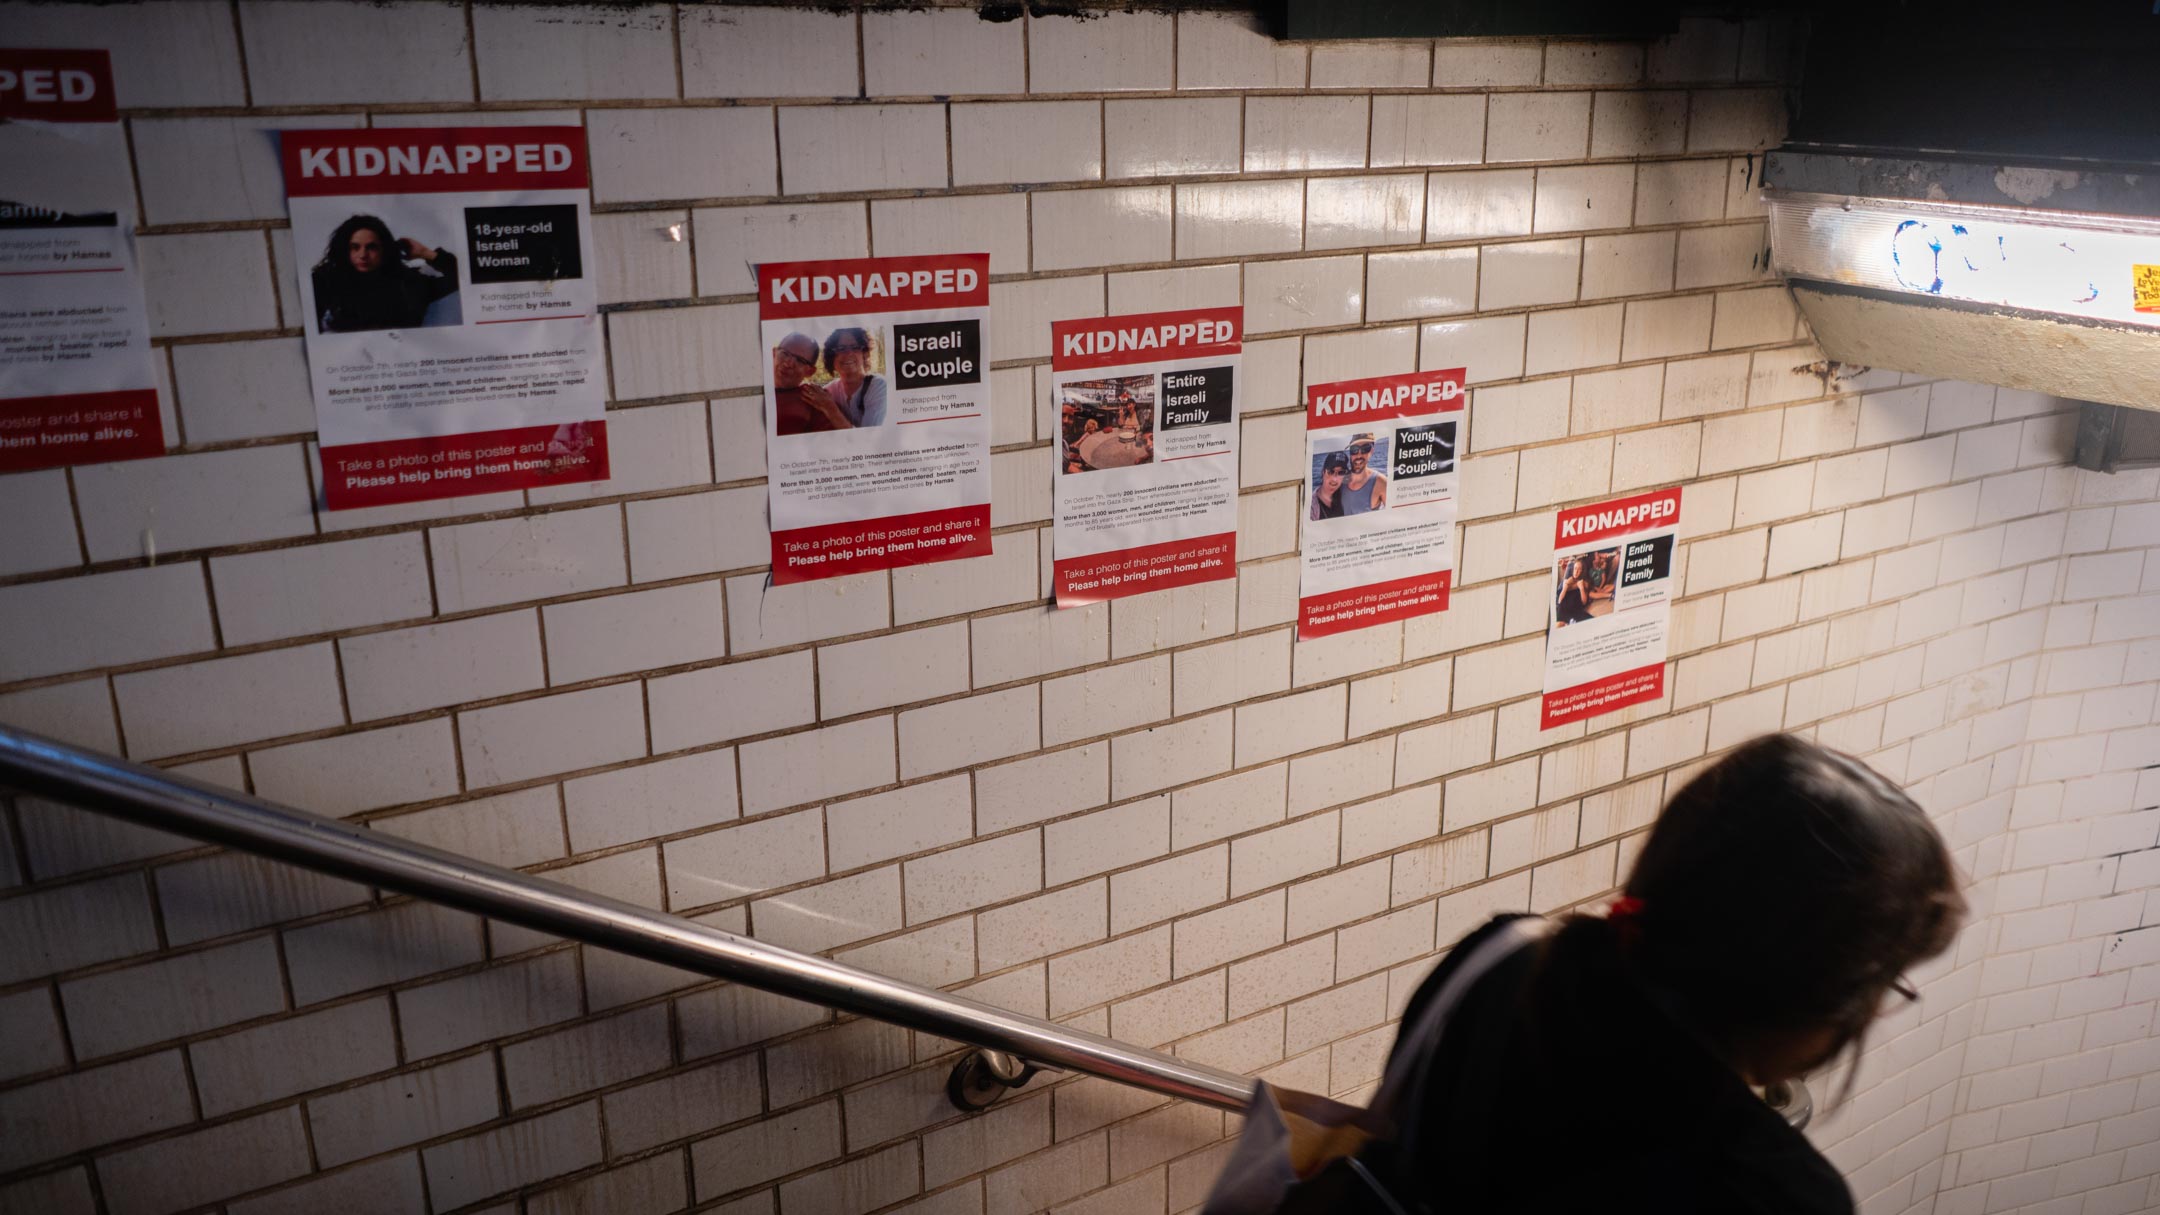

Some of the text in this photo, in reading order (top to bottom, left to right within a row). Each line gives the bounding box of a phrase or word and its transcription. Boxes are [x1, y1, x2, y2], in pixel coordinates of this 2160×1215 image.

[299, 143, 572, 177] KIDNAPPED
[474, 221, 552, 237] 18-year-old
[475, 238, 518, 251] Israeli
[476, 255, 530, 267] Woman
[771, 268, 978, 303] KIDNAPPED
[479, 288, 552, 301] Kidnapped from
[900, 330, 961, 352] Israeli
[1063, 320, 1234, 356] KIDNAPPED
[901, 356, 972, 379] Couple
[1166, 374, 1205, 388] Entire
[901, 394, 940, 404] Kidnapped
[939, 403, 949, 411] by
[950, 401, 974, 409] Hamas
[1166, 390, 1206, 406] Israeli
[1315, 380, 1458, 416] KIDNAPPED
[1166, 408, 1209, 424] Family
[1165, 433, 1211, 443] Kidnapped from
[1400, 428, 1436, 443] Young
[864, 451, 893, 459] innocent
[894, 449, 920, 457] civilians
[936, 443, 965, 452] abducted
[1165, 444, 1178, 453] their
[1206, 439, 1226, 447] Hamas
[1398, 444, 1432, 459] Israeli
[337, 459, 372, 472] Take
[375, 459, 385, 469] a
[388, 453, 428, 469] photo
[431, 450, 444, 463] of
[447, 449, 472, 461] this
[474, 445, 516, 460] poster
[519, 440, 544, 454] and
[346, 475, 395, 488] Please
[398, 470, 431, 483] help
[434, 467, 472, 479] bring
[474, 462, 510, 475] them
[512, 459, 551, 470] home
[1397, 459, 1438, 475] Couple
[1561, 498, 1675, 538] KIDNAPPED
[783, 517, 980, 552] Take a photo of this poster and share it
[788, 533, 976, 566] Please help bring them home alive.
[1628, 543, 1654, 556] Entire
[1063, 543, 1227, 579] Take a photo of this poster and share it
[1626, 554, 1653, 569] Israeli
[1068, 558, 1223, 592] Please help bring them home alive.
[1624, 567, 1654, 582] Family
[1306, 580, 1444, 614] Take a photo of this poster and share it
[1308, 593, 1439, 626] Please help bring them home alive.
[1548, 699, 1563, 708] Take
[1568, 692, 1587, 704] photo
[1586, 689, 1594, 697] of
[1594, 687, 1605, 695] this
[1605, 681, 1624, 693] poster
[1625, 677, 1637, 686] and
[1637, 673, 1654, 685] share
[1654, 671, 1659, 679] it
[1549, 683, 1655, 717] Please help bring them home alive.
